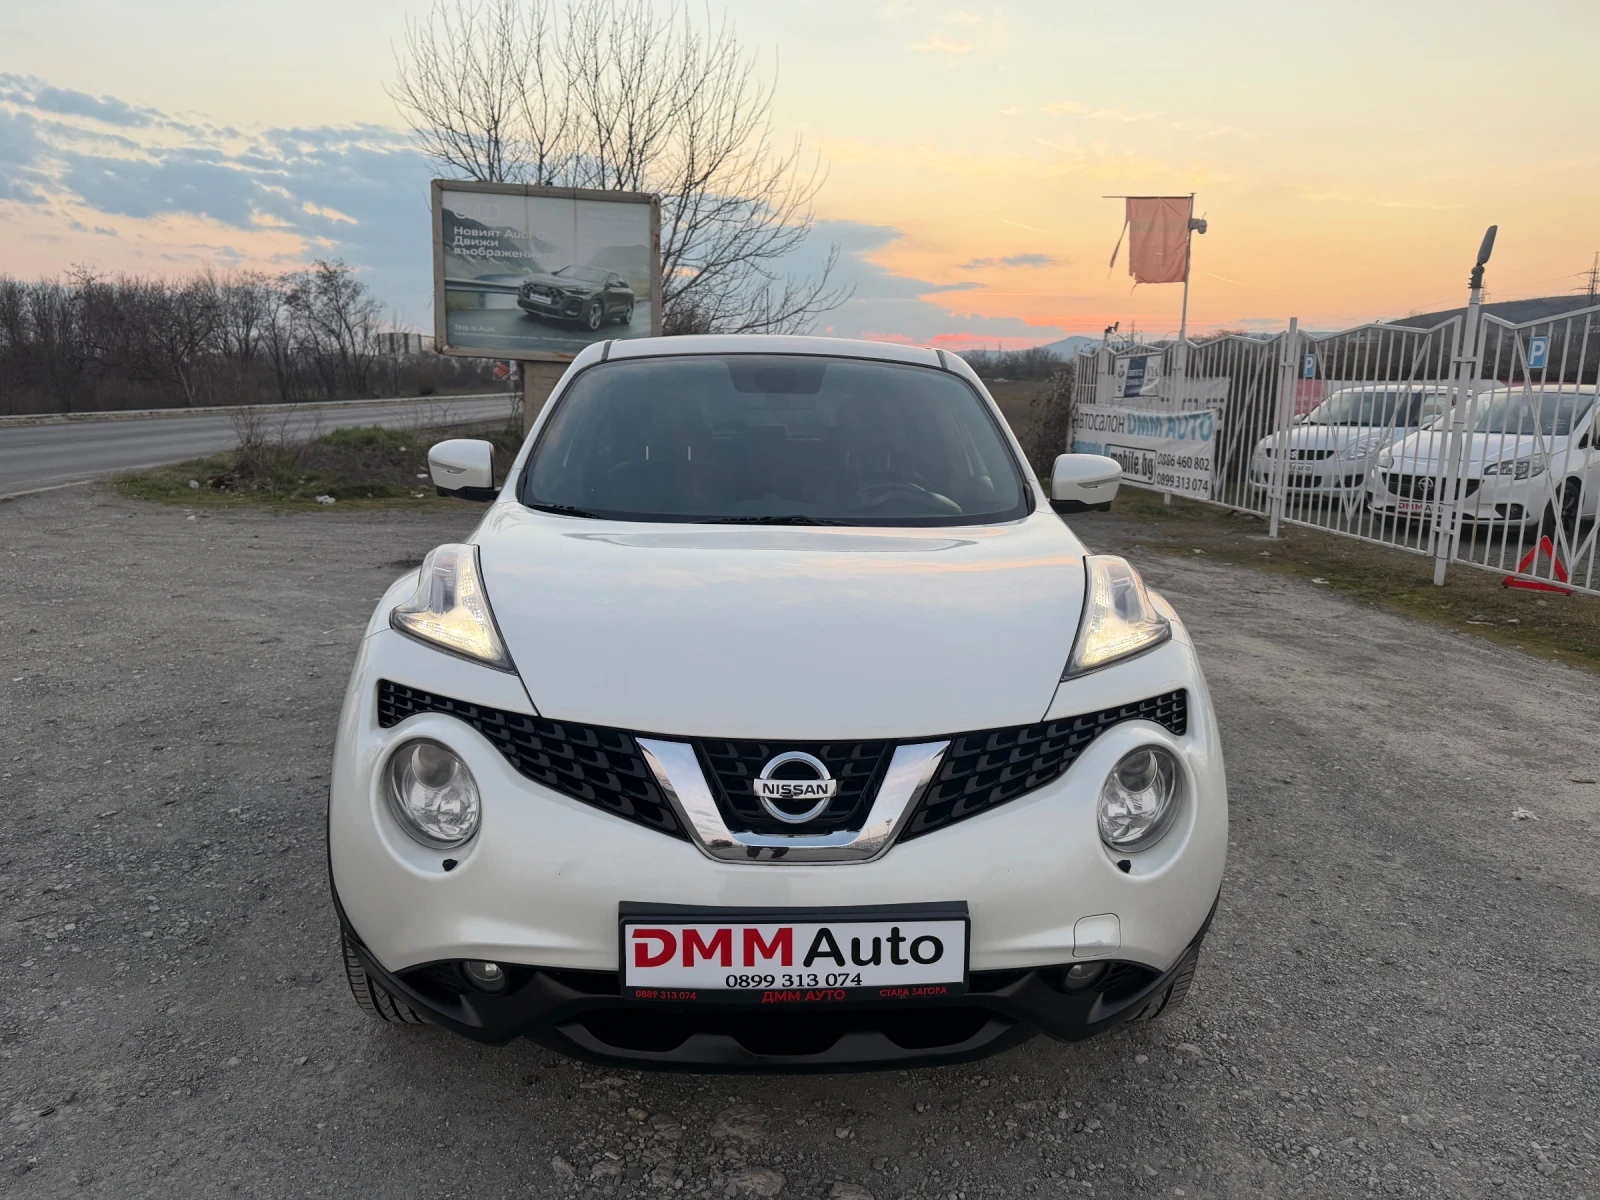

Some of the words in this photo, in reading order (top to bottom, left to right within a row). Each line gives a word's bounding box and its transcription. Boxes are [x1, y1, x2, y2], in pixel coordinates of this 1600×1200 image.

[453, 225, 501, 238] Новият
[504, 229, 532, 240] Audi
[453, 235, 499, 247] Движи
[454, 324, 470, 332] This
[1127, 413, 1163, 438] DMM
[1165, 412, 1214, 442] AUTO
[1157, 453, 1176, 467] 0886
[1176, 455, 1193, 469] 460
[1194, 457, 1210, 471] 802
[1157, 473, 1175, 487] 0899
[1176, 475, 1190, 490] 313
[1191, 478, 1209, 493] 074
[762, 783, 829, 796] NISSAN
[631, 927, 794, 968] DMM
[802, 926, 944, 967] Auto
[725, 974, 776, 988] 0899
[781, 973, 819, 988] 313
[825, 972, 862, 987] 074
[660, 990, 677, 999] 313
[679, 991, 697, 1000] 074
[762, 990, 800, 1004] ДММ
[805, 989, 846, 1001] АУТО
[879, 988, 909, 997] СТАРА
[911, 986, 948, 996] ЗАГОРА
